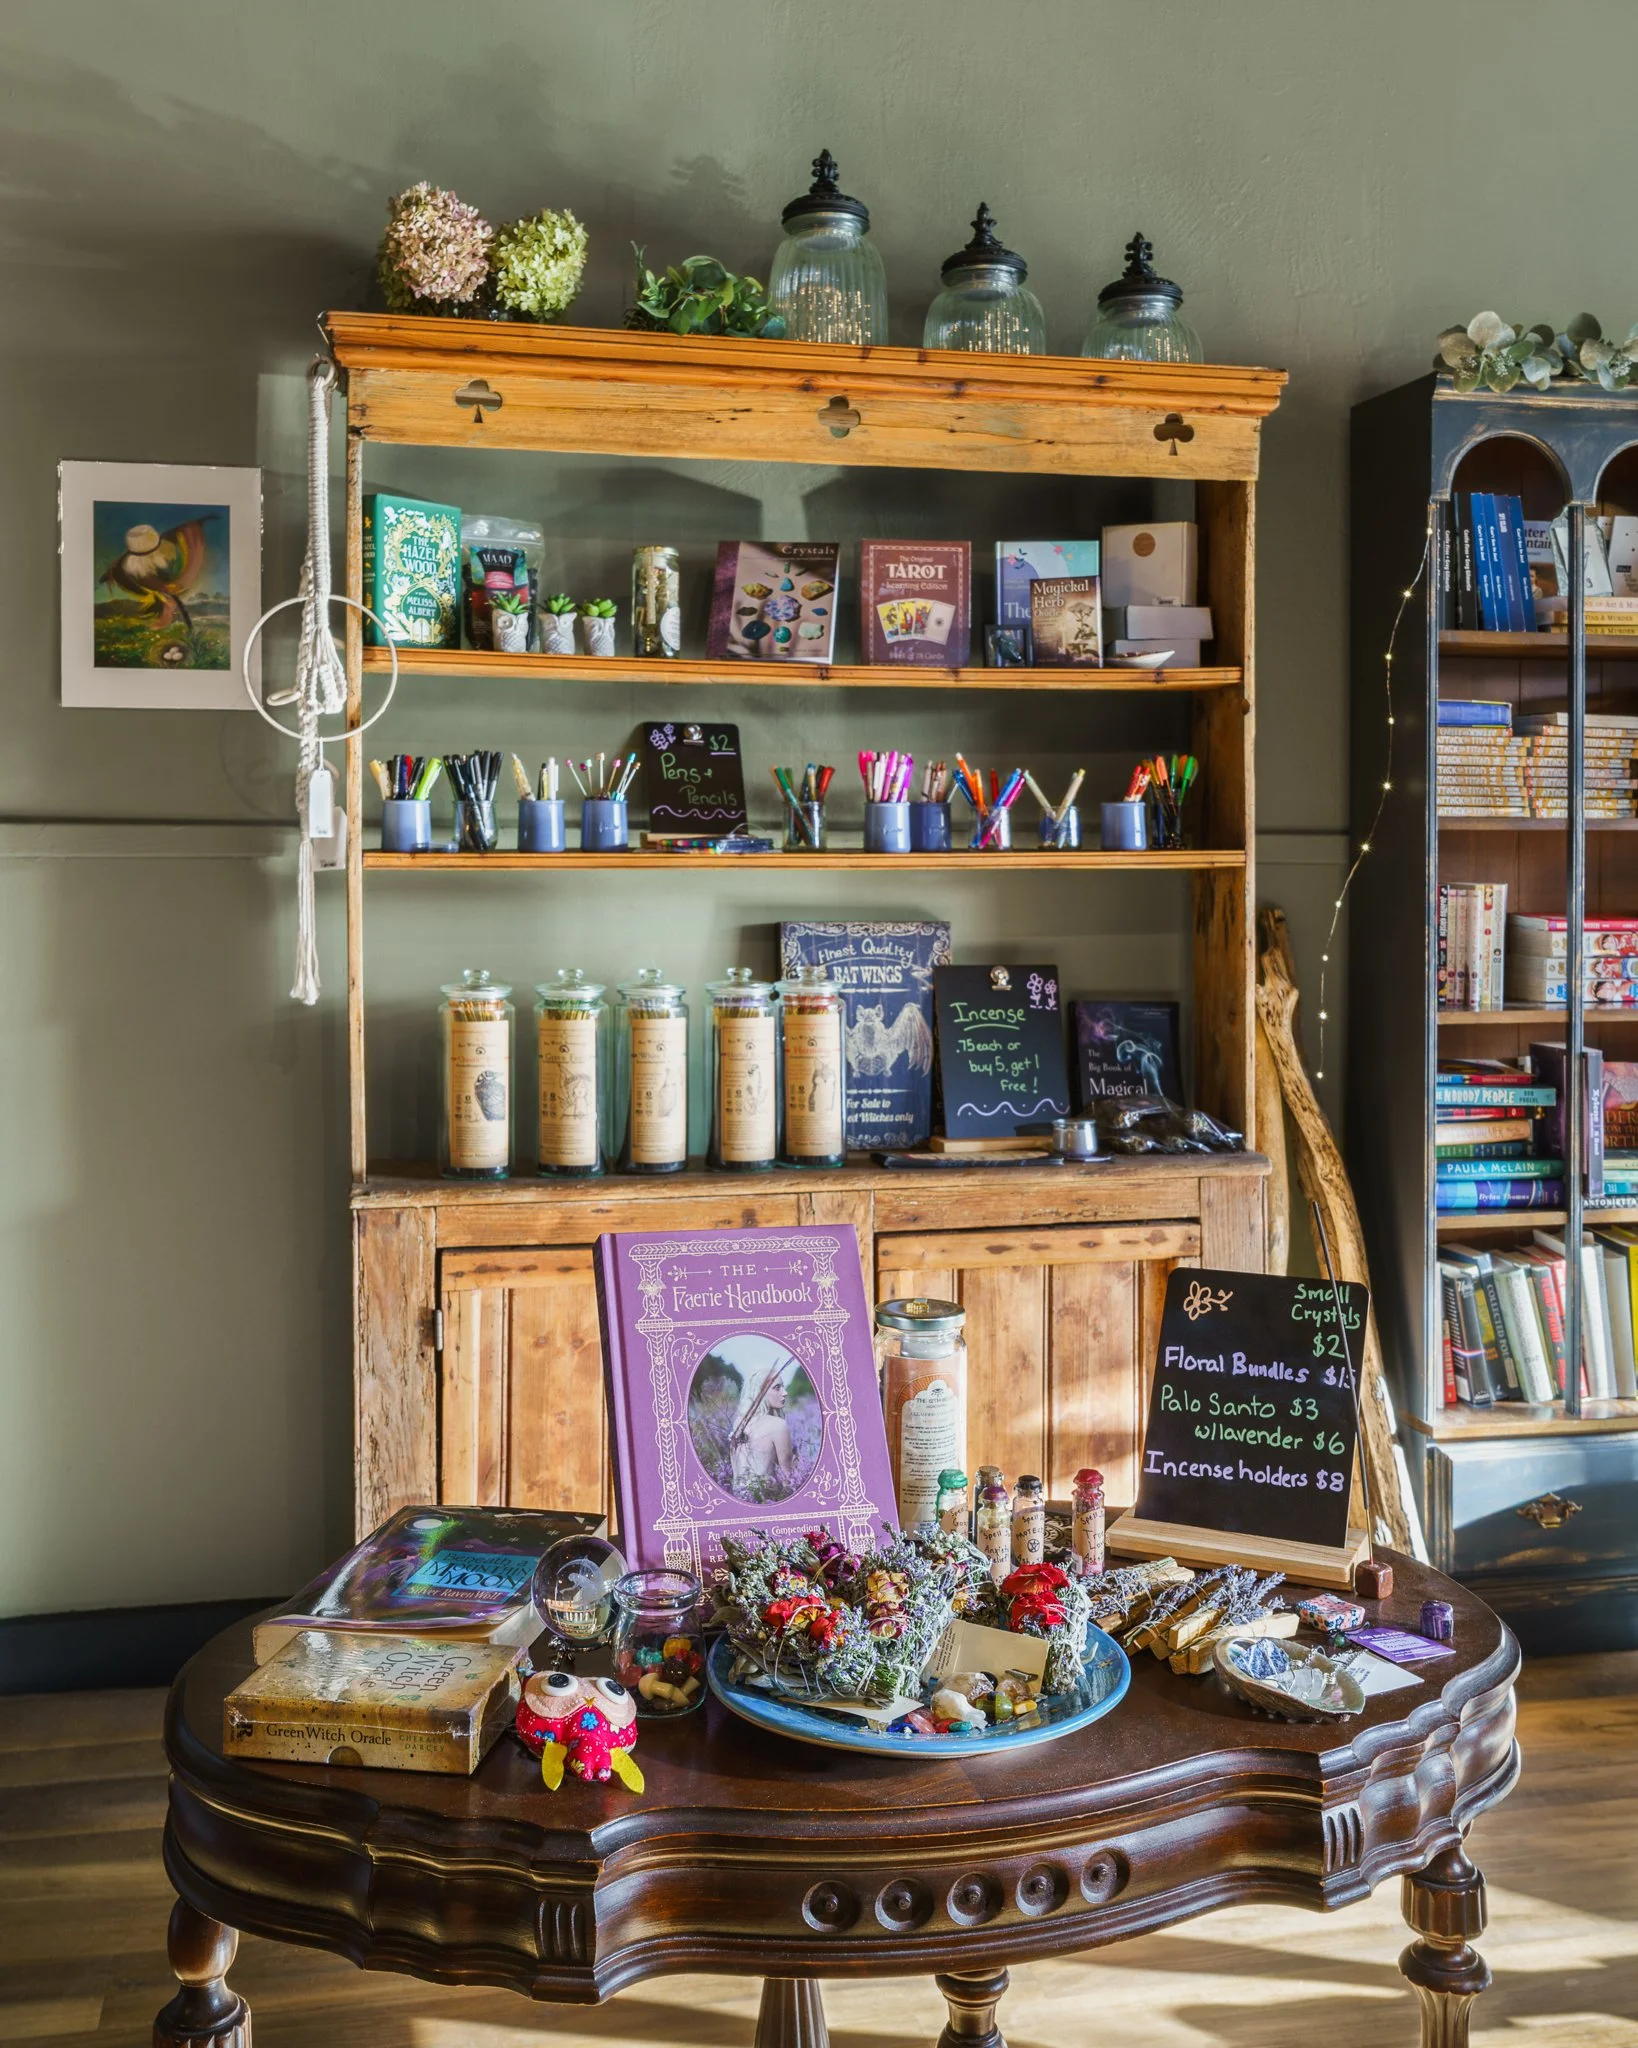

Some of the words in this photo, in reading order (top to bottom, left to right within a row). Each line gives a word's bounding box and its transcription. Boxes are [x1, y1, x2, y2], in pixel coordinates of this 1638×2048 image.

[413, 536, 429, 547] THE
[403, 544, 439, 562] HAZEL
[782, 545, 835, 557] Crystals
[402, 558, 437, 574] WOOD
[885, 562, 948, 579] TAROT
[886, 581, 920, 591] Learning
[921, 582, 948, 590] Edition
[1034, 580, 1089, 596] Magickal
[407, 596, 438, 608] MELISSA
[1034, 596, 1064, 608] Herb
[408, 607, 435, 618] ALBERT
[709, 735, 735, 750] $2
[661, 752, 701, 783] Pens
[680, 785, 737, 806] Pencils
[833, 966, 859, 984] BAT
[860, 966, 903, 984] WINGS
[950, 1002, 1026, 1023] Incense
[1007, 1042, 1021, 1050] or
[968, 1060, 993, 1076] buy
[1011, 1057, 1031, 1077] get
[1103, 1062, 1122, 1072] Book
[1090, 1078, 1148, 1096] Magical
[1444, 1088, 1479, 1104] NOBODY
[1482, 1087, 1515, 1104] PEOPLE
[859, 1112, 894, 1123] Witches
[895, 1112, 914, 1124] only
[1447, 1163, 1486, 1173] PAULA
[1491, 1163, 1535, 1173] McLAIN
[720, 1264, 757, 1277] THE
[672, 1286, 722, 1313] Faerie
[724, 1282, 813, 1313] Handbook
[1487, 1284, 1506, 1338] COLLECTED
[1312, 1332, 1345, 1358] $2
[1164, 1346, 1225, 1373] Floral
[1232, 1352, 1310, 1384] Bundles
[1161, 1384, 1201, 1412] Palo
[1209, 1392, 1276, 1418] Santo
[1290, 1397, 1319, 1420] $3
[1313, 1431, 1345, 1455] $6
[1143, 1450, 1234, 1480] Incense
[1239, 1459, 1308, 1488] holders
[1316, 1469, 1345, 1492] $8
[707, 1531, 721, 1541] An
[983, 1531, 1002, 1540] Spell
[444, 1553, 510, 1567] Beneath
[517, 1559, 528, 1567] a
[437, 1571, 525, 1589] MOON
[407, 1585, 439, 1597] Silver
[360, 1652, 413, 1688] Oracle
[388, 1653, 446, 1690] Witch
[420, 1656, 472, 1692] Green
[350, 1729, 392, 1746] Oracle
[405, 1743, 445, 1751] DARCEY
